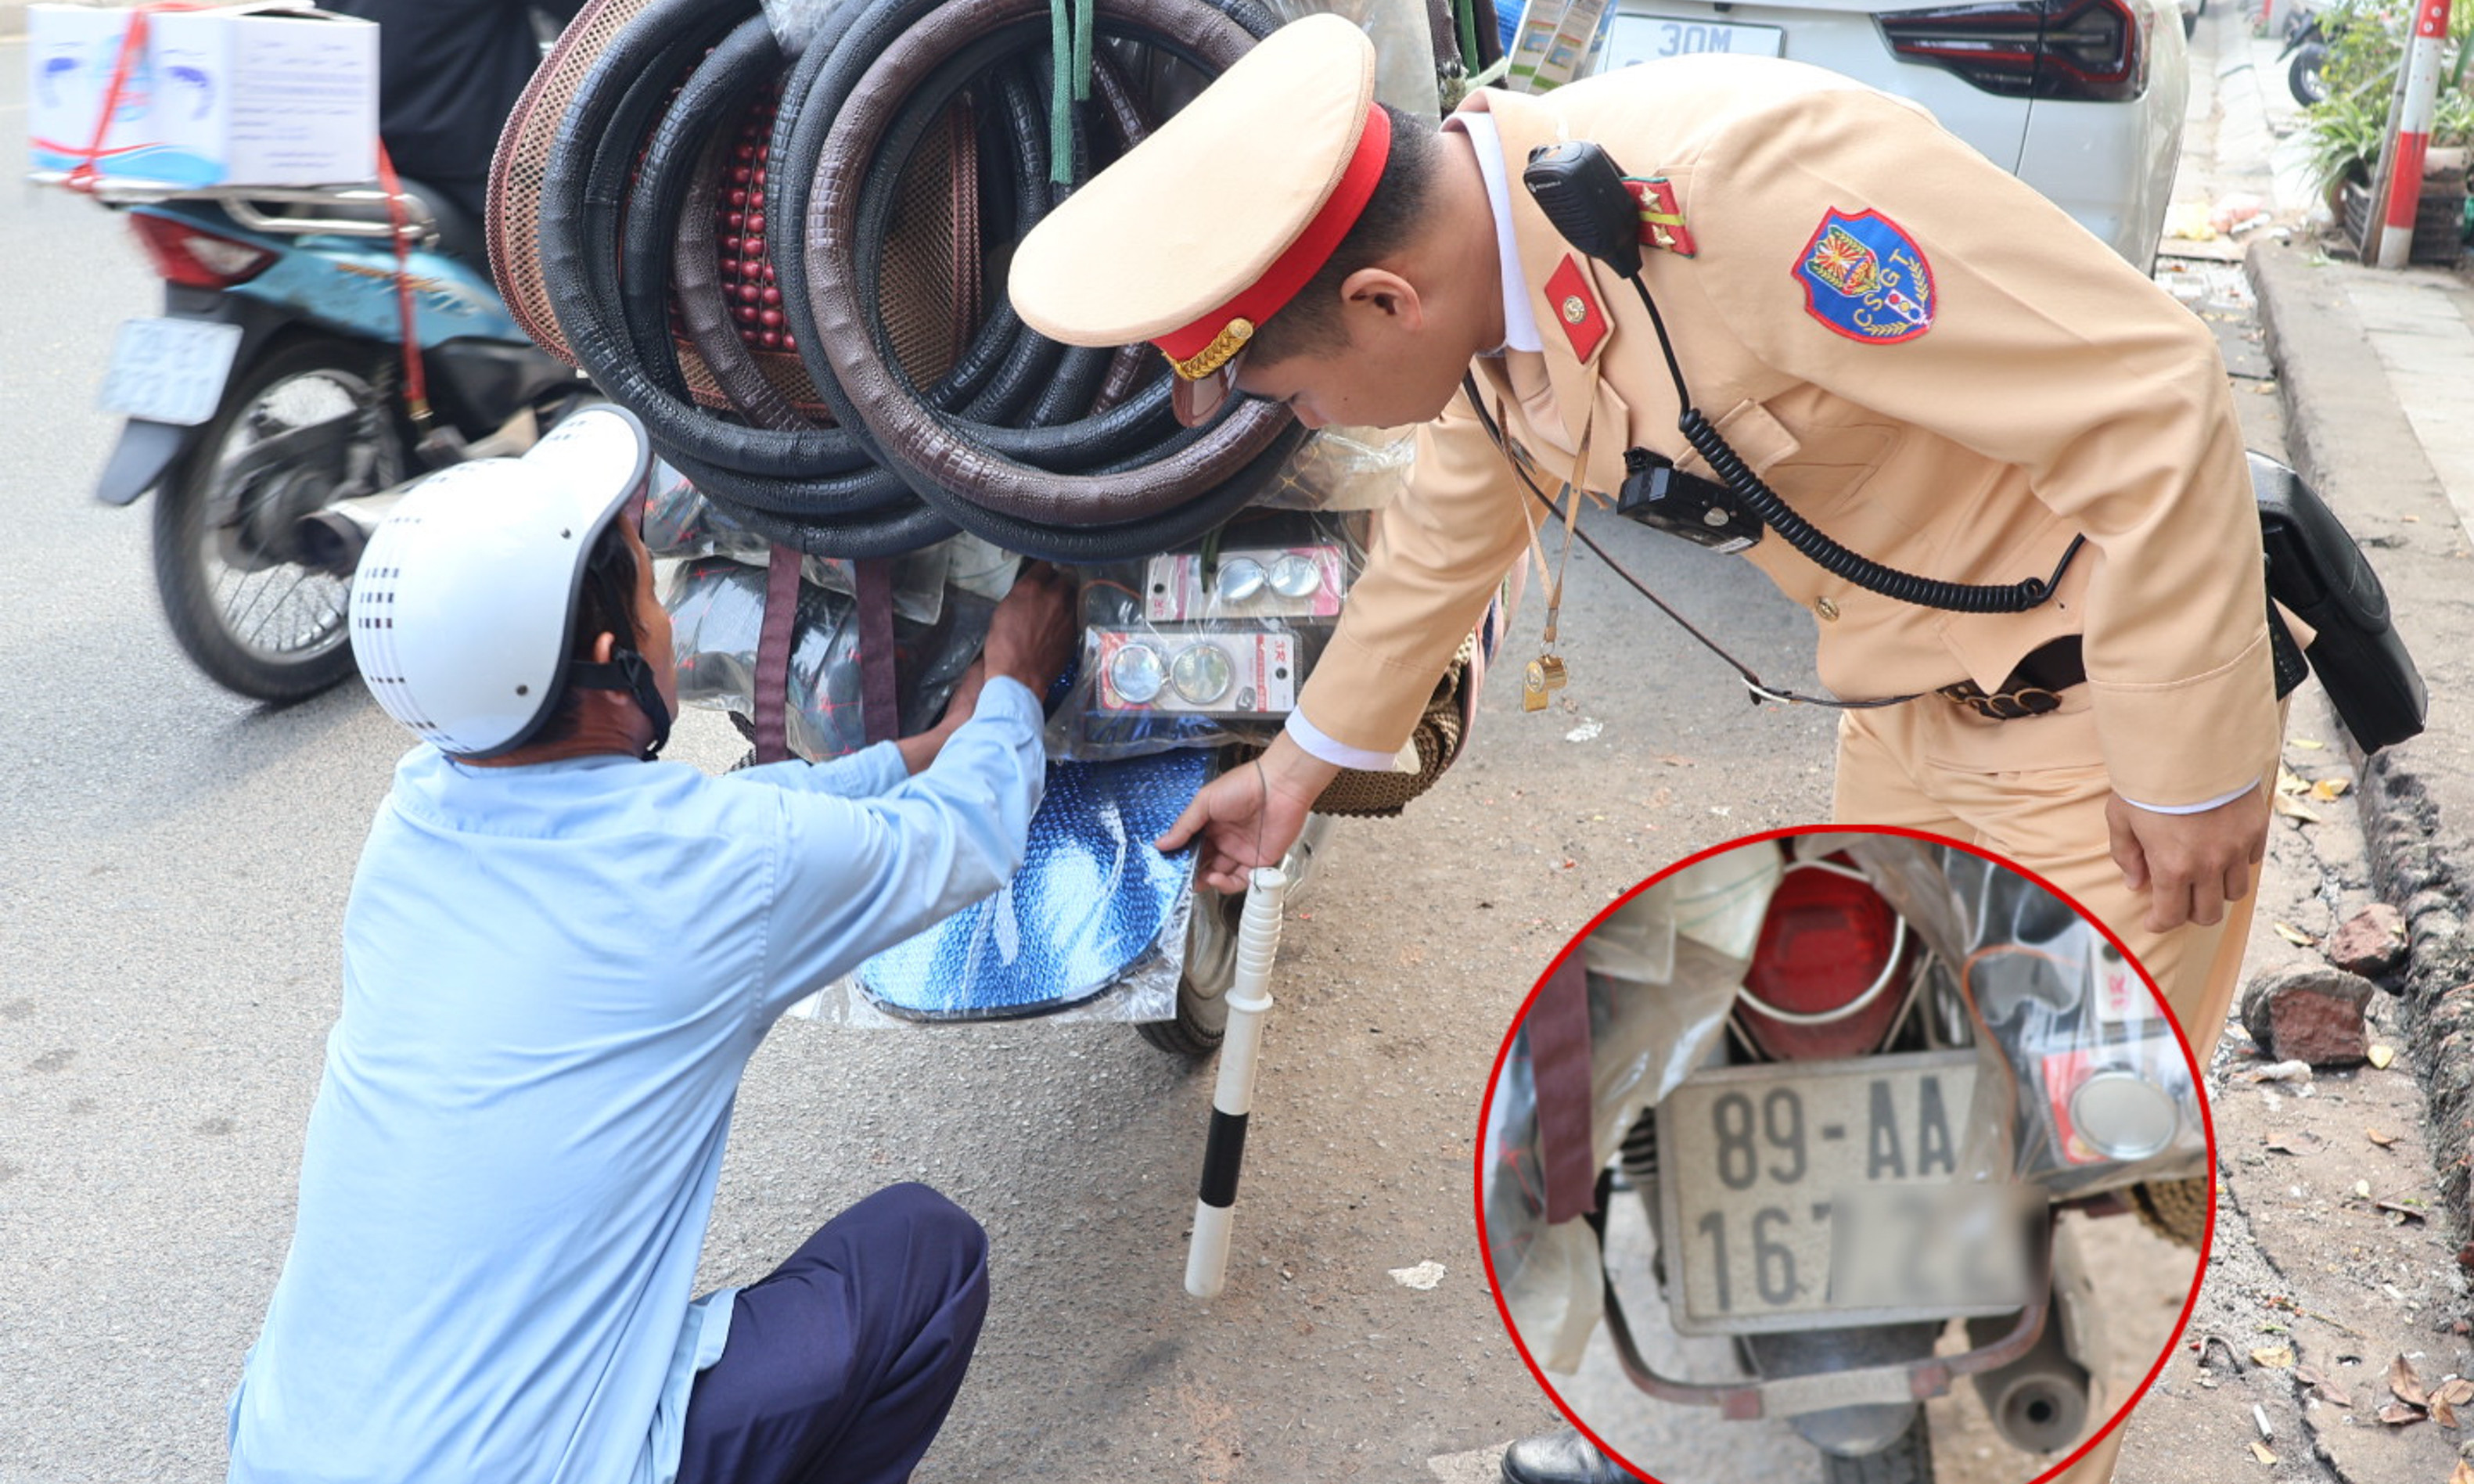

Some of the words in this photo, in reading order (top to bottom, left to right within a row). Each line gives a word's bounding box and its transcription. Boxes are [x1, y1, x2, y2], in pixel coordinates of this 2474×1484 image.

[1658, 23, 1732, 56] 30M
[1854, 248, 1908, 327] CSGT
[1712, 1076, 1954, 1190] 89-AA
